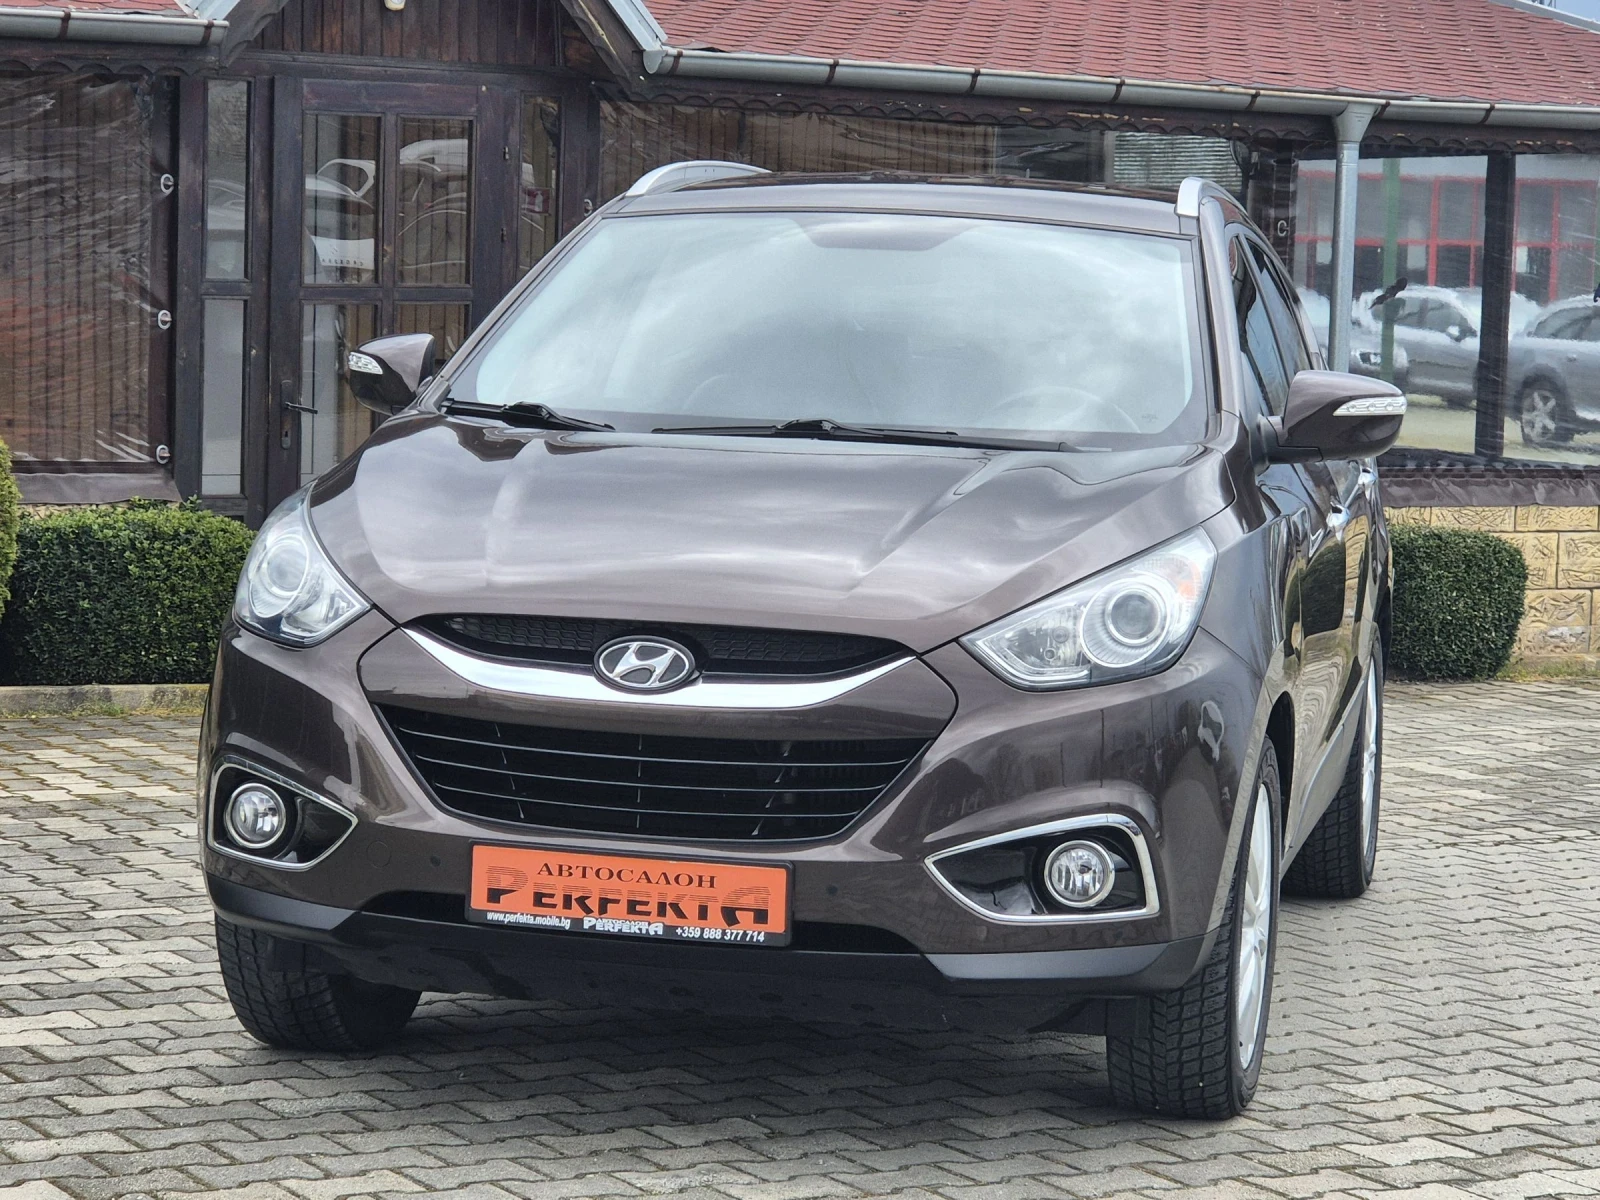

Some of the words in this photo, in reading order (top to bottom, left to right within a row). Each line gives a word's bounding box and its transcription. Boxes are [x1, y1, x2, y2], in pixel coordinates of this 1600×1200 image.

[537, 863, 717, 888] АВТОСАЛОН
[487, 912, 571, 930] www.perfekta.mobile.bg
[676, 926, 701, 939] +359
[703, 928, 722, 940] 888
[724, 929, 743, 941] 377
[746, 930, 765, 942] 714
